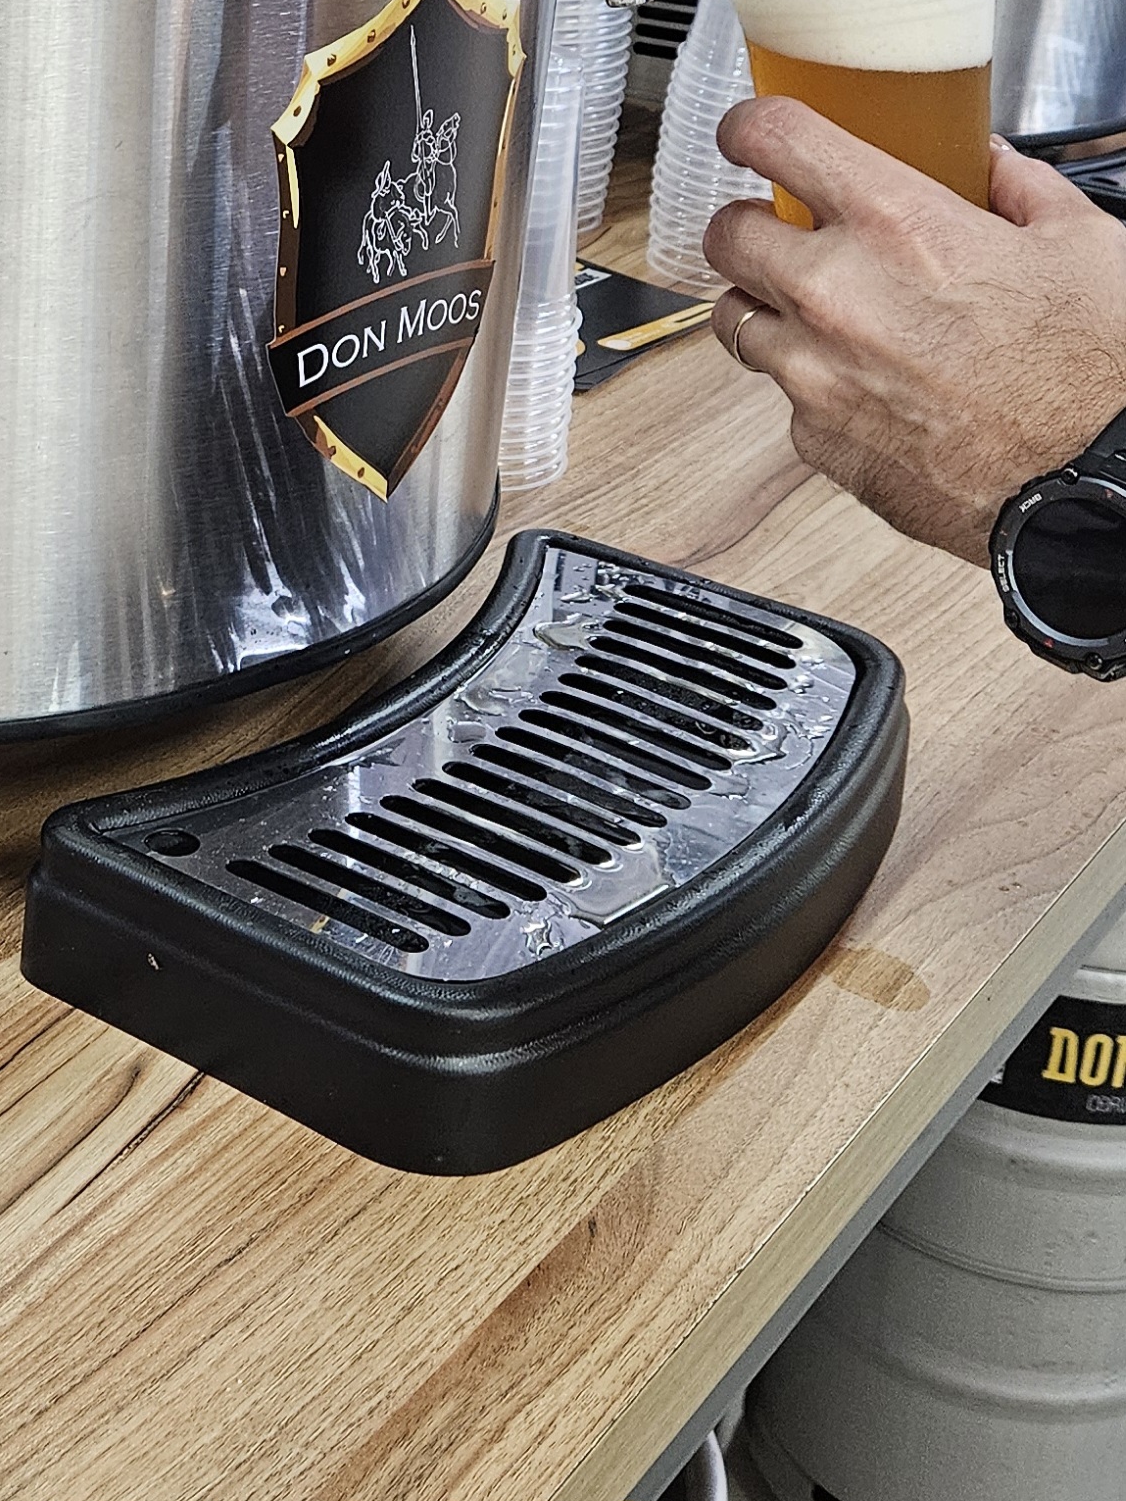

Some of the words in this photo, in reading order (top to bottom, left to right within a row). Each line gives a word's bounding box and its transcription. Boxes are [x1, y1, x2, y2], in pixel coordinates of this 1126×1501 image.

[297, 318, 386, 388] DON
[396, 289, 482, 344] MOOS
[998, 554, 1009, 592] SELECT
